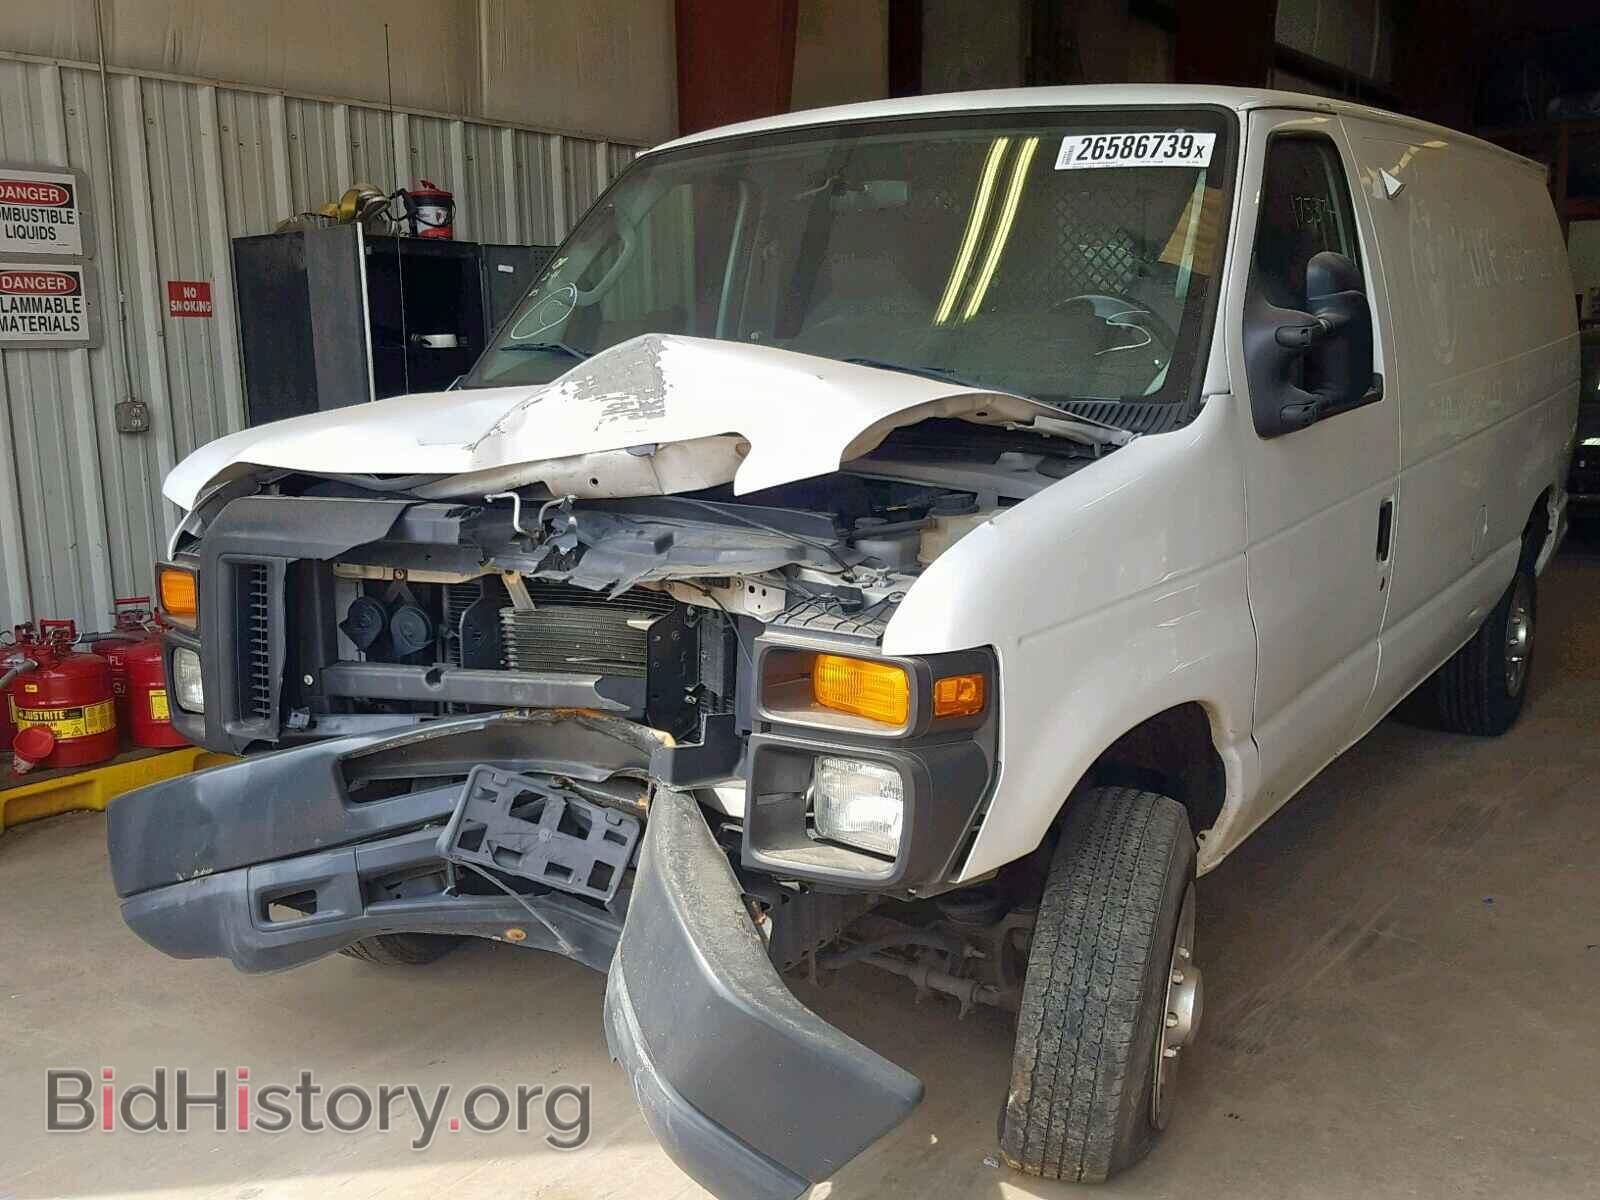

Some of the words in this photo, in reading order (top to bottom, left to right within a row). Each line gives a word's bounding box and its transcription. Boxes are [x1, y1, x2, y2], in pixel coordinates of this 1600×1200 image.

[0, 206, 75, 225] MBUSTIBLE
[5, 224, 57, 241] LIQUIDS
[1, 276, 67, 290] DANGER
[183, 287, 197, 299] NO
[0, 297, 81, 314] LAMMABLE
[171, 301, 213, 313] SMOKING
[0, 315, 80, 332] MATERIALS
